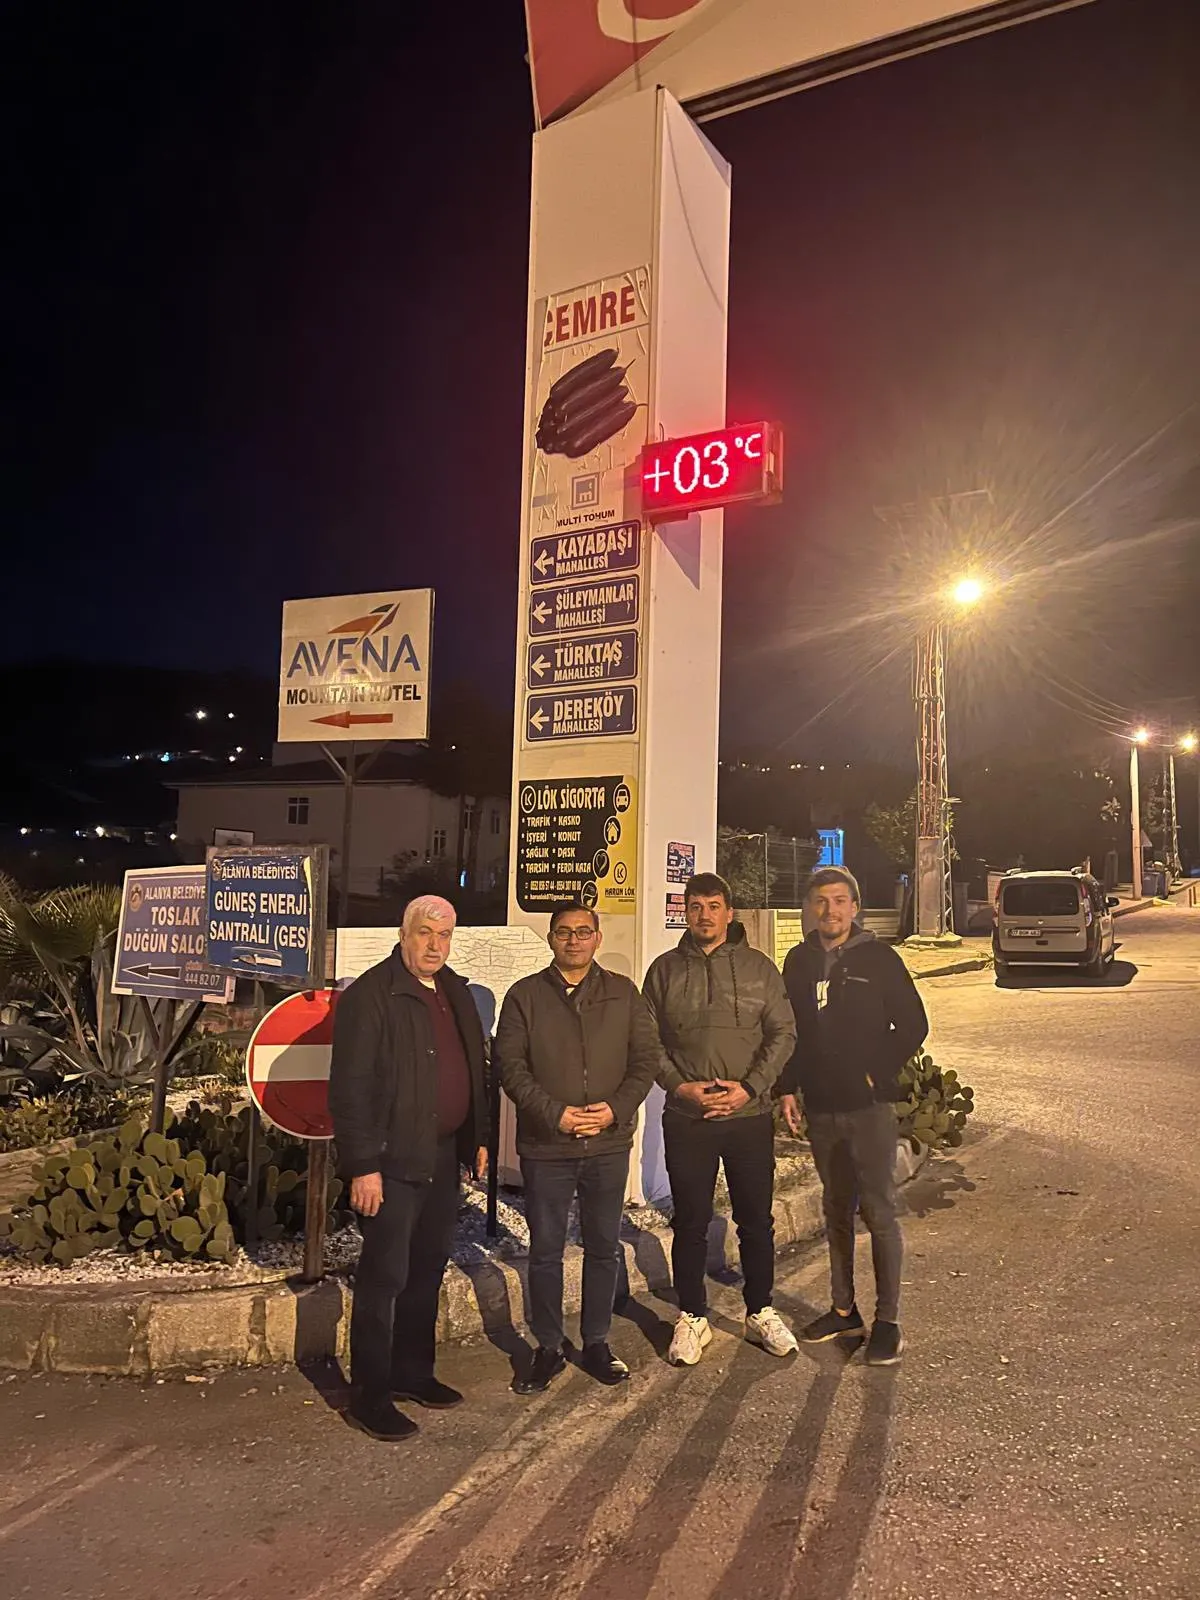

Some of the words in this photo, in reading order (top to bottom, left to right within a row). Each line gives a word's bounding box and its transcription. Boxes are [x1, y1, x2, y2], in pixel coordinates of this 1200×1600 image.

[644, 440, 729, 493] +03
[583, 509, 615, 522] TOHUM
[557, 527, 633, 560] KAYABAŞI
[556, 551, 608, 576] MAHALLESİ
[556, 583, 634, 611] SÜLEYMANLAR
[555, 605, 606, 629] MAHALLESİ
[286, 633, 421, 678] AVENA
[554, 639, 623, 667] TÜRKTAŞ
[554, 663, 603, 682] MAHALLESİ
[286, 687, 365, 705] MOUNTAIN
[370, 684, 421, 703] HOTEL
[553, 691, 624, 721] DEREKÖY
[552, 716, 603, 735] MAHALLESİ
[537, 785, 558, 810] LÖK
[560, 784, 605, 810] SİGORTA
[526, 815, 551, 828] TRAFİK
[558, 815, 581, 826] KASKO
[526, 831, 547, 845] İŞYERİ
[558, 831, 581, 842] KONUT
[526, 846, 549, 858] SAĞLIK
[557, 847, 576, 858] DASK
[221, 864, 250, 880] ALANYA
[252, 862, 298, 880] BELEDİYESİ
[526, 861, 550, 874] TARSİM
[557, 861, 574, 874] FERDİ
[575, 862, 591, 873] KAZA
[144, 886, 171, 900] ALANYA
[214, 886, 257, 918] GÜNEŞ
[260, 888, 307, 915] ENERJİ
[151, 906, 200, 926] TOSLAK
[123, 928, 168, 952] DÜĞÜN
[171, 933, 208, 956] SALO
[209, 919, 269, 945] SANTRALİ
[184, 973, 198, 985] 444
[210, 974, 220, 987] 07
